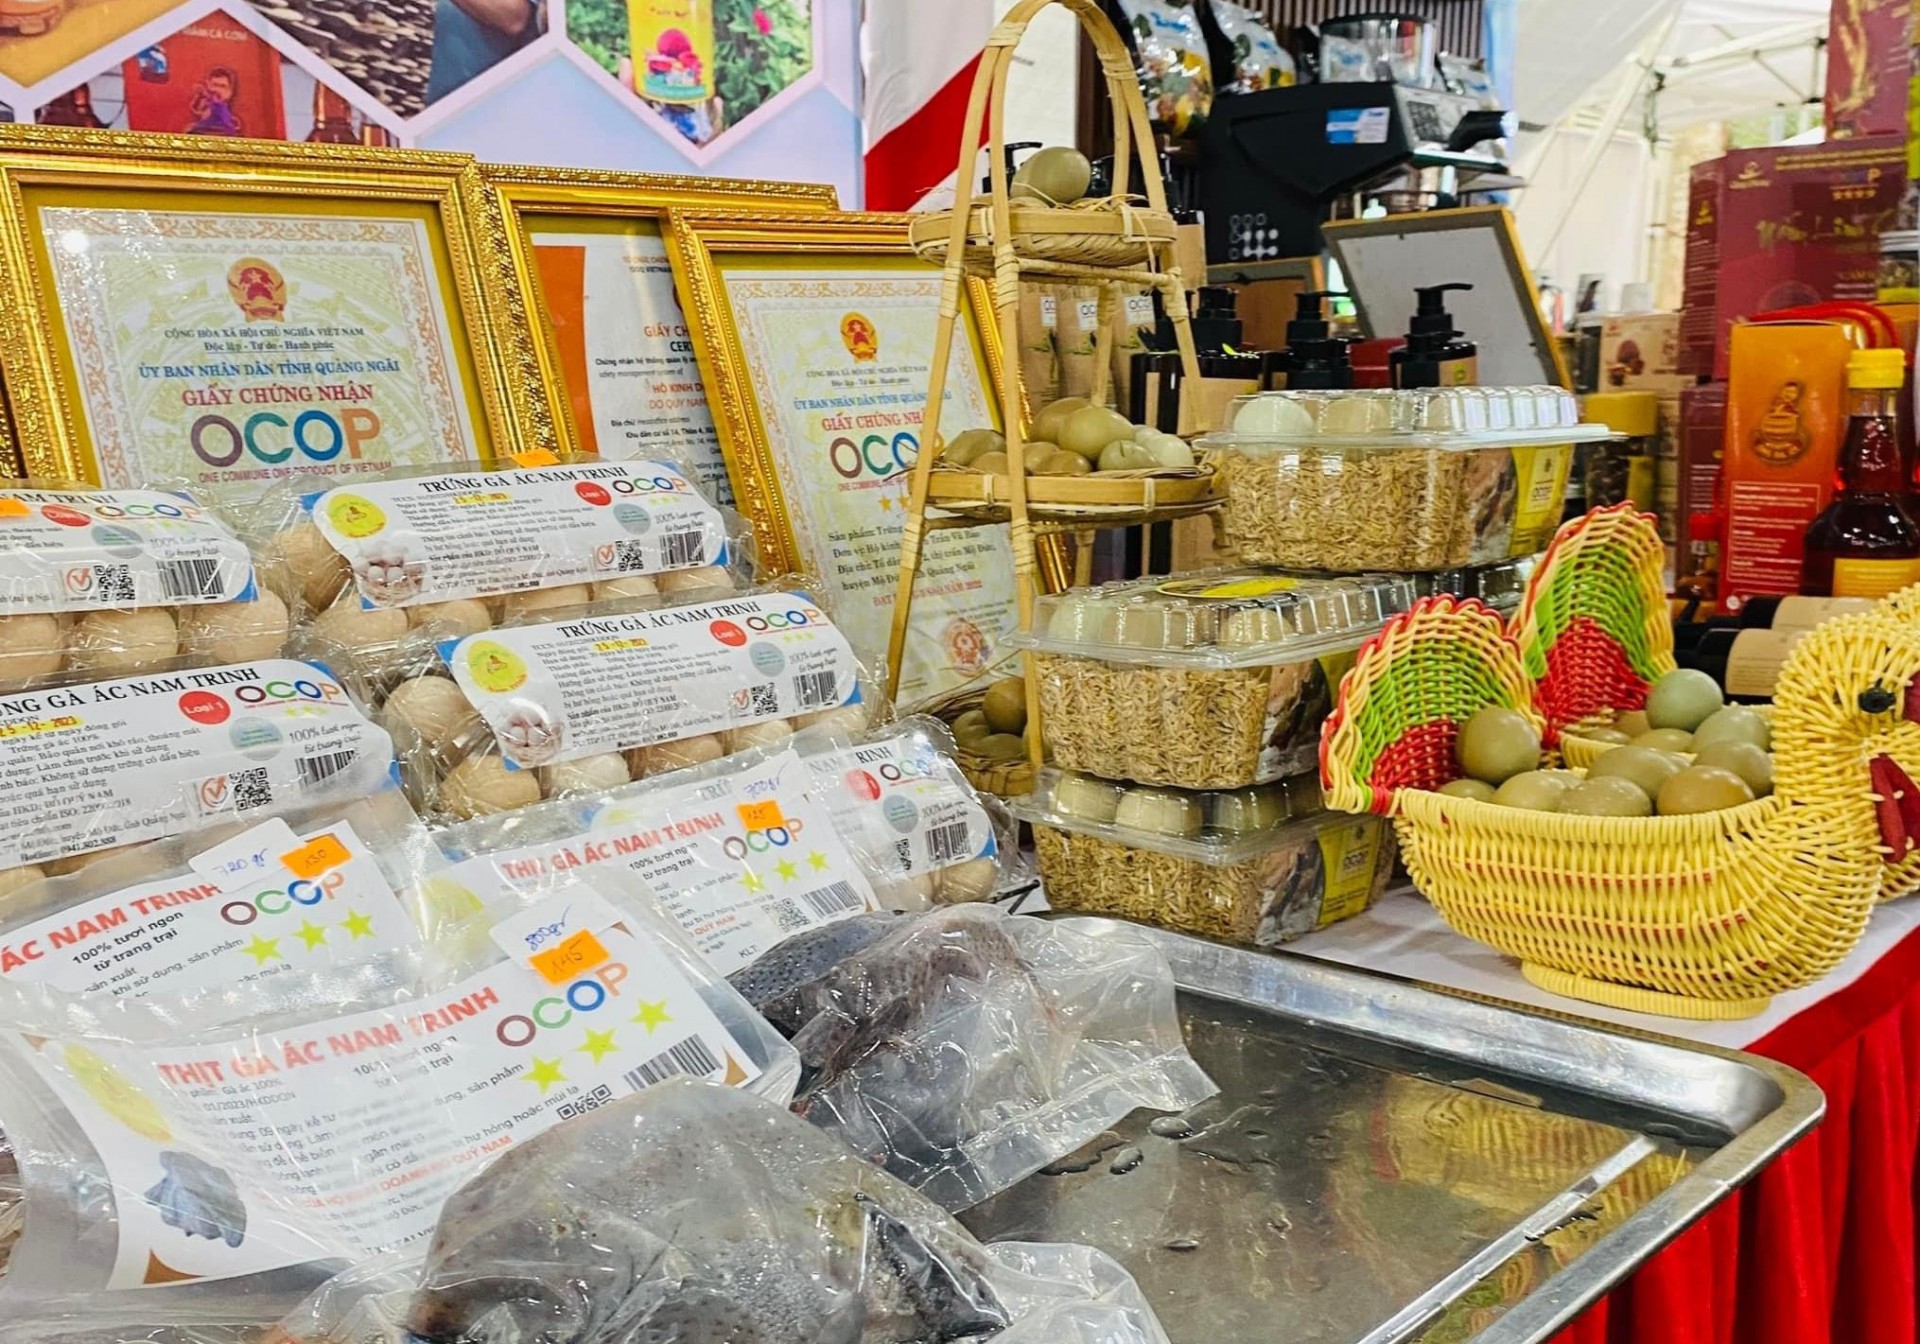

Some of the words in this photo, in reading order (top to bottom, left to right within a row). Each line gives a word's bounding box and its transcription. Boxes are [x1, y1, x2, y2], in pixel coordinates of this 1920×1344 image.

[342, 327, 365, 336] NAM
[164, 365, 195, 377] BAN
[199, 362, 241, 376] NHÂN
[244, 362, 274, 376] DÂN
[181, 382, 232, 407] GIẤY
[239, 381, 313, 404] CHỨNG
[318, 379, 374, 405] NHẬN
[190, 407, 381, 468] OCOP
[222, 469, 269, 482] COMMUNE
[419, 477, 482, 494] TRỨNG
[484, 473, 510, 488] GÀ
[539, 469, 577, 483] NAM
[578, 466, 629, 481] TRINH
[612, 476, 687, 494] OCOP
[95, 503, 200, 518] OCOP
[557, 619, 620, 639] TRỨNG
[621, 615, 646, 632] GÀ
[650, 610, 674, 629] ÁC
[672, 607, 712, 625] NAM
[712, 601, 762, 618] TRINH
[746, 608, 820, 631] OCOP
[46, 688, 87, 709] GÀ
[95, 685, 128, 703] ÁC
[128, 677, 187, 697] NAM
[189, 667, 261, 692] TRINH
[235, 680, 340, 703] OCOP
[289, 727, 320, 744] 100%
[551, 846, 582, 870] GÀ
[583, 838, 613, 862] ÁC
[614, 828, 662, 858] NAM
[662, 811, 726, 841] TRINH
[722, 817, 804, 861] OCOP
[220, 871, 345, 925] OCOP
[0, 939, 44, 974] ÁC
[50, 907, 127, 949] NAM
[129, 883, 223, 919] TRINH
[72, 941, 112, 965] 100%
[113, 925, 146, 946] tươi
[148, 911, 184, 931] ngon
[93, 957, 111, 973] từ
[113, 941, 153, 963] trang
[153, 928, 178, 945] trại
[188, 950, 210, 965] sản
[211, 937, 244, 957] phẩm
[496, 962, 629, 1048] OCOP
[158, 1060, 224, 1089] THỊT
[231, 1050, 281, 1080] GÀ
[283, 1035, 327, 1070] ÁC
[330, 1021, 404, 1058] NAM
[405, 987, 500, 1036] TRINH
[490, 1061, 524, 1087] phẩm
[513, 1104, 543, 1123] hoặc
[481, 1134, 514, 1153] NAM
